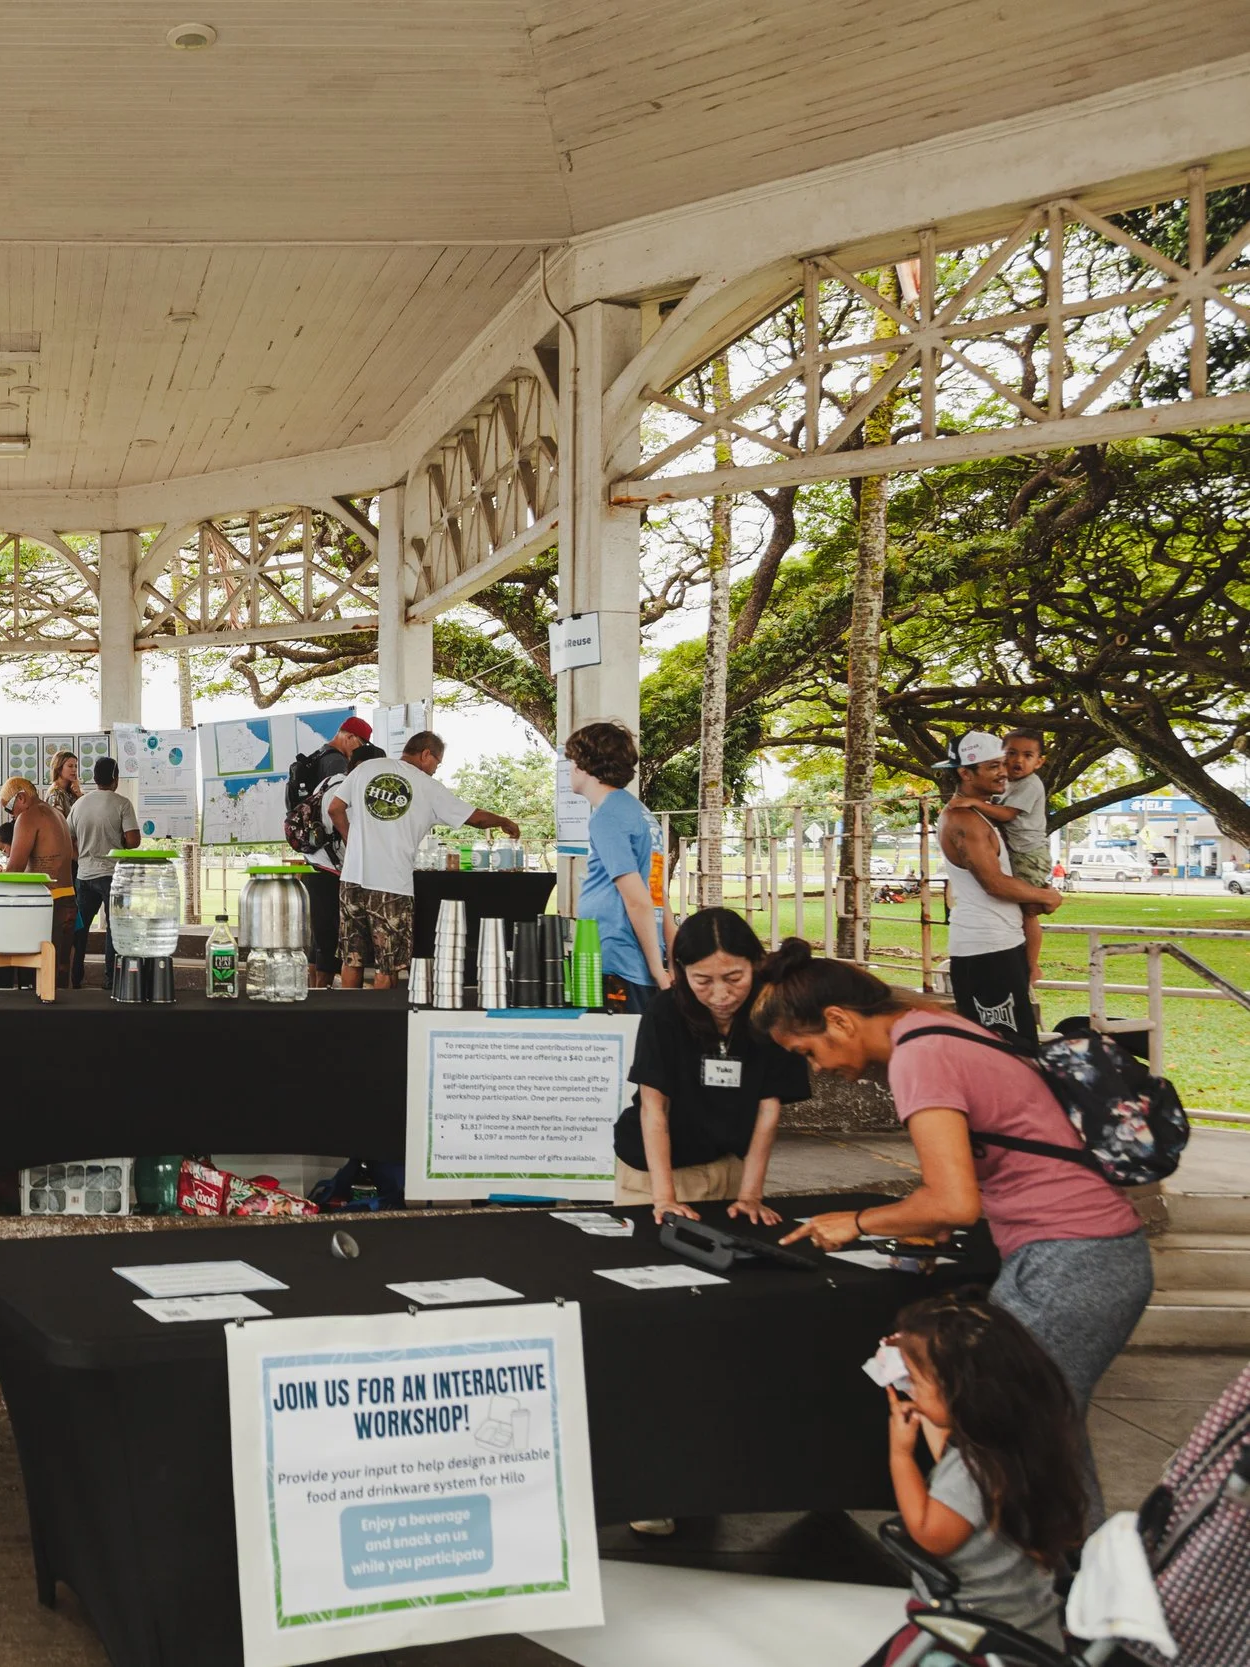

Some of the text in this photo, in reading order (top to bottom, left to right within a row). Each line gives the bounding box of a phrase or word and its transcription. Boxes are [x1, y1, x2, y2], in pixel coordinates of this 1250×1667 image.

[1130, 800, 1173, 812] HELE
[455, 1042, 489, 1051] recognize
[490, 1042, 502, 1050] the
[535, 1044, 583, 1052] contributions
[534, 1054, 562, 1063] offering
[442, 1073, 469, 1082] Eligible
[470, 1074, 512, 1082] participants
[587, 1075, 599, 1084] gift
[516, 1084, 531, 1092] they
[552, 1085, 590, 1093] completed
[446, 1093, 481, 1101] workshop
[435, 1113, 467, 1122] Eligibility
[475, 1114, 500, 1122] guided
[547, 1155, 563, 1163] gifts
[273, 1364, 547, 1411] JOIN US FOR AN INTERACTIVE
[354, 1404, 470, 1440] WORKSHOP!
[278, 1448, 550, 1485] Provide your input to help design a reusable
[306, 1471, 525, 1504] food and drinkware system for Hilo
[361, 1509, 471, 1534] Enjoy a beverage
[365, 1529, 468, 1552] and snack on us
[351, 1548, 485, 1576] while you participate
